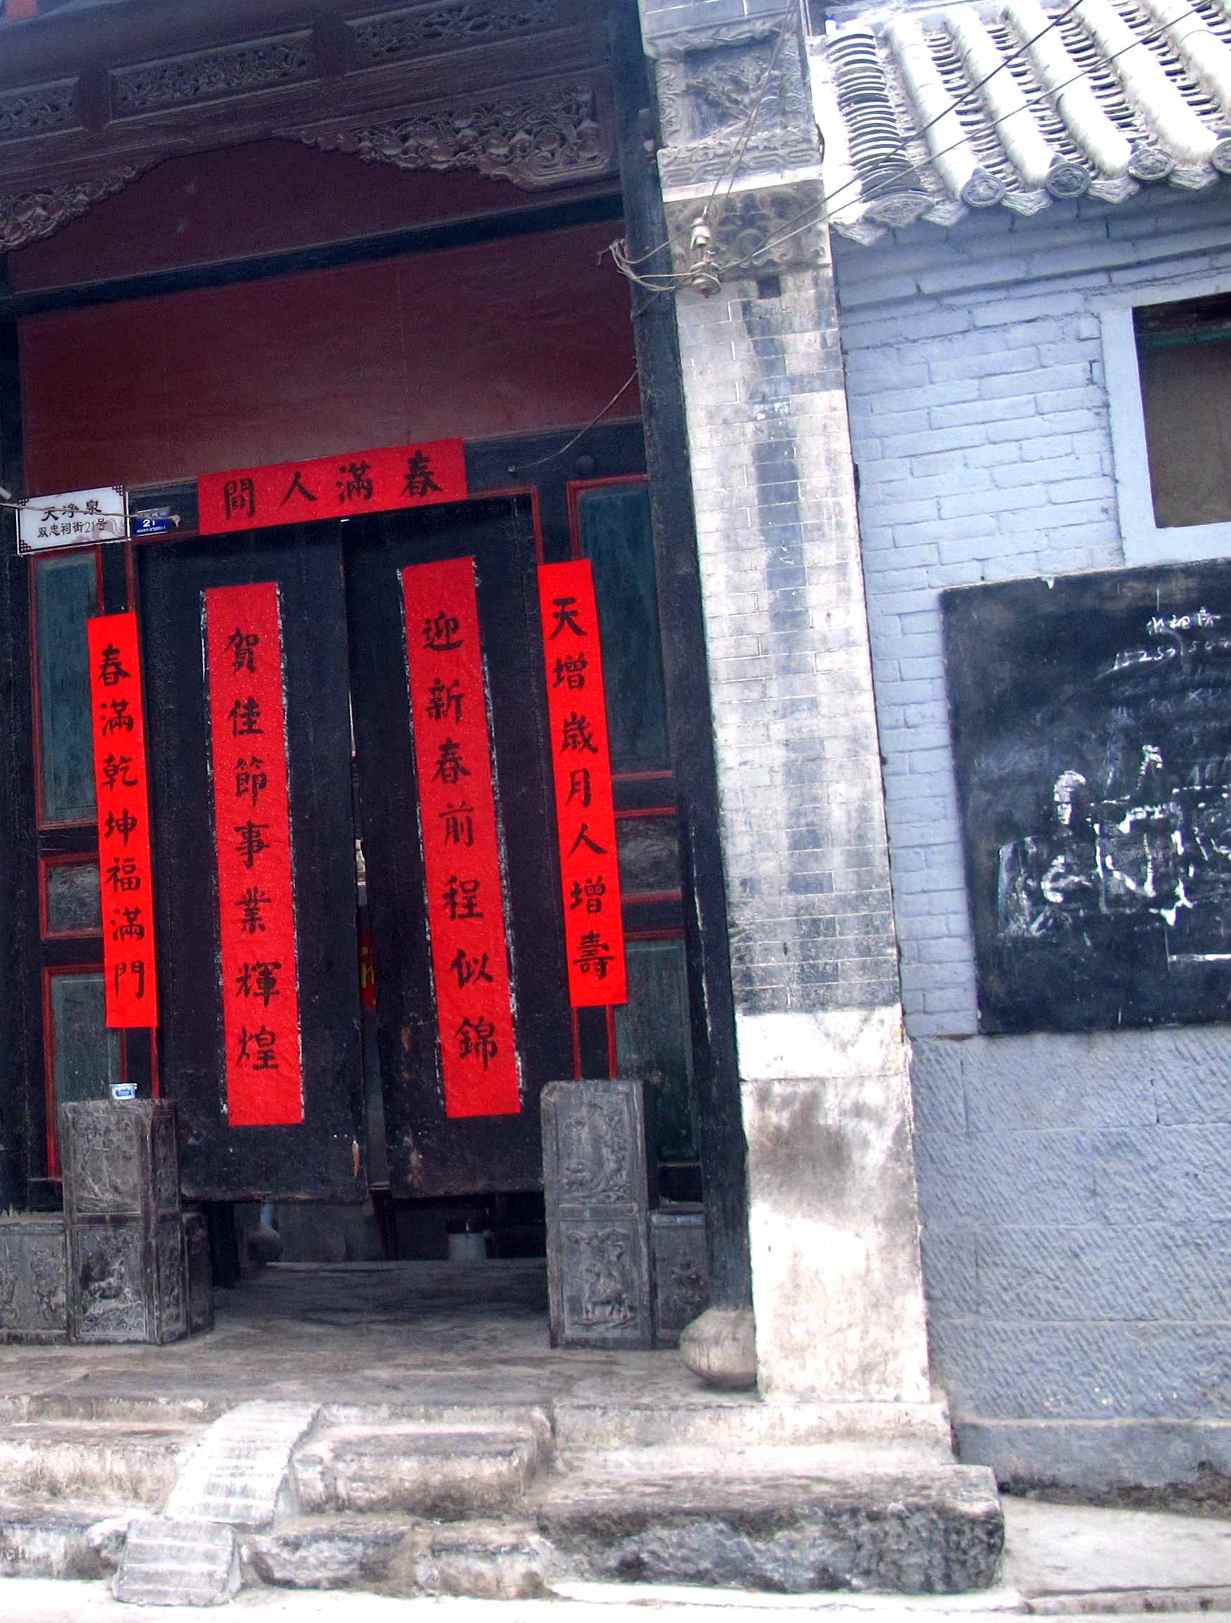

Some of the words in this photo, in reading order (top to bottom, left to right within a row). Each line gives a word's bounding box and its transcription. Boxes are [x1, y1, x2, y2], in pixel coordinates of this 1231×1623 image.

[96, 644, 147, 1000] 春滿乾坤福滿門
[227, 628, 281, 1072] 賀佳節事業輝煌
[422, 612, 499, 1072] 迎新春前程似錦
